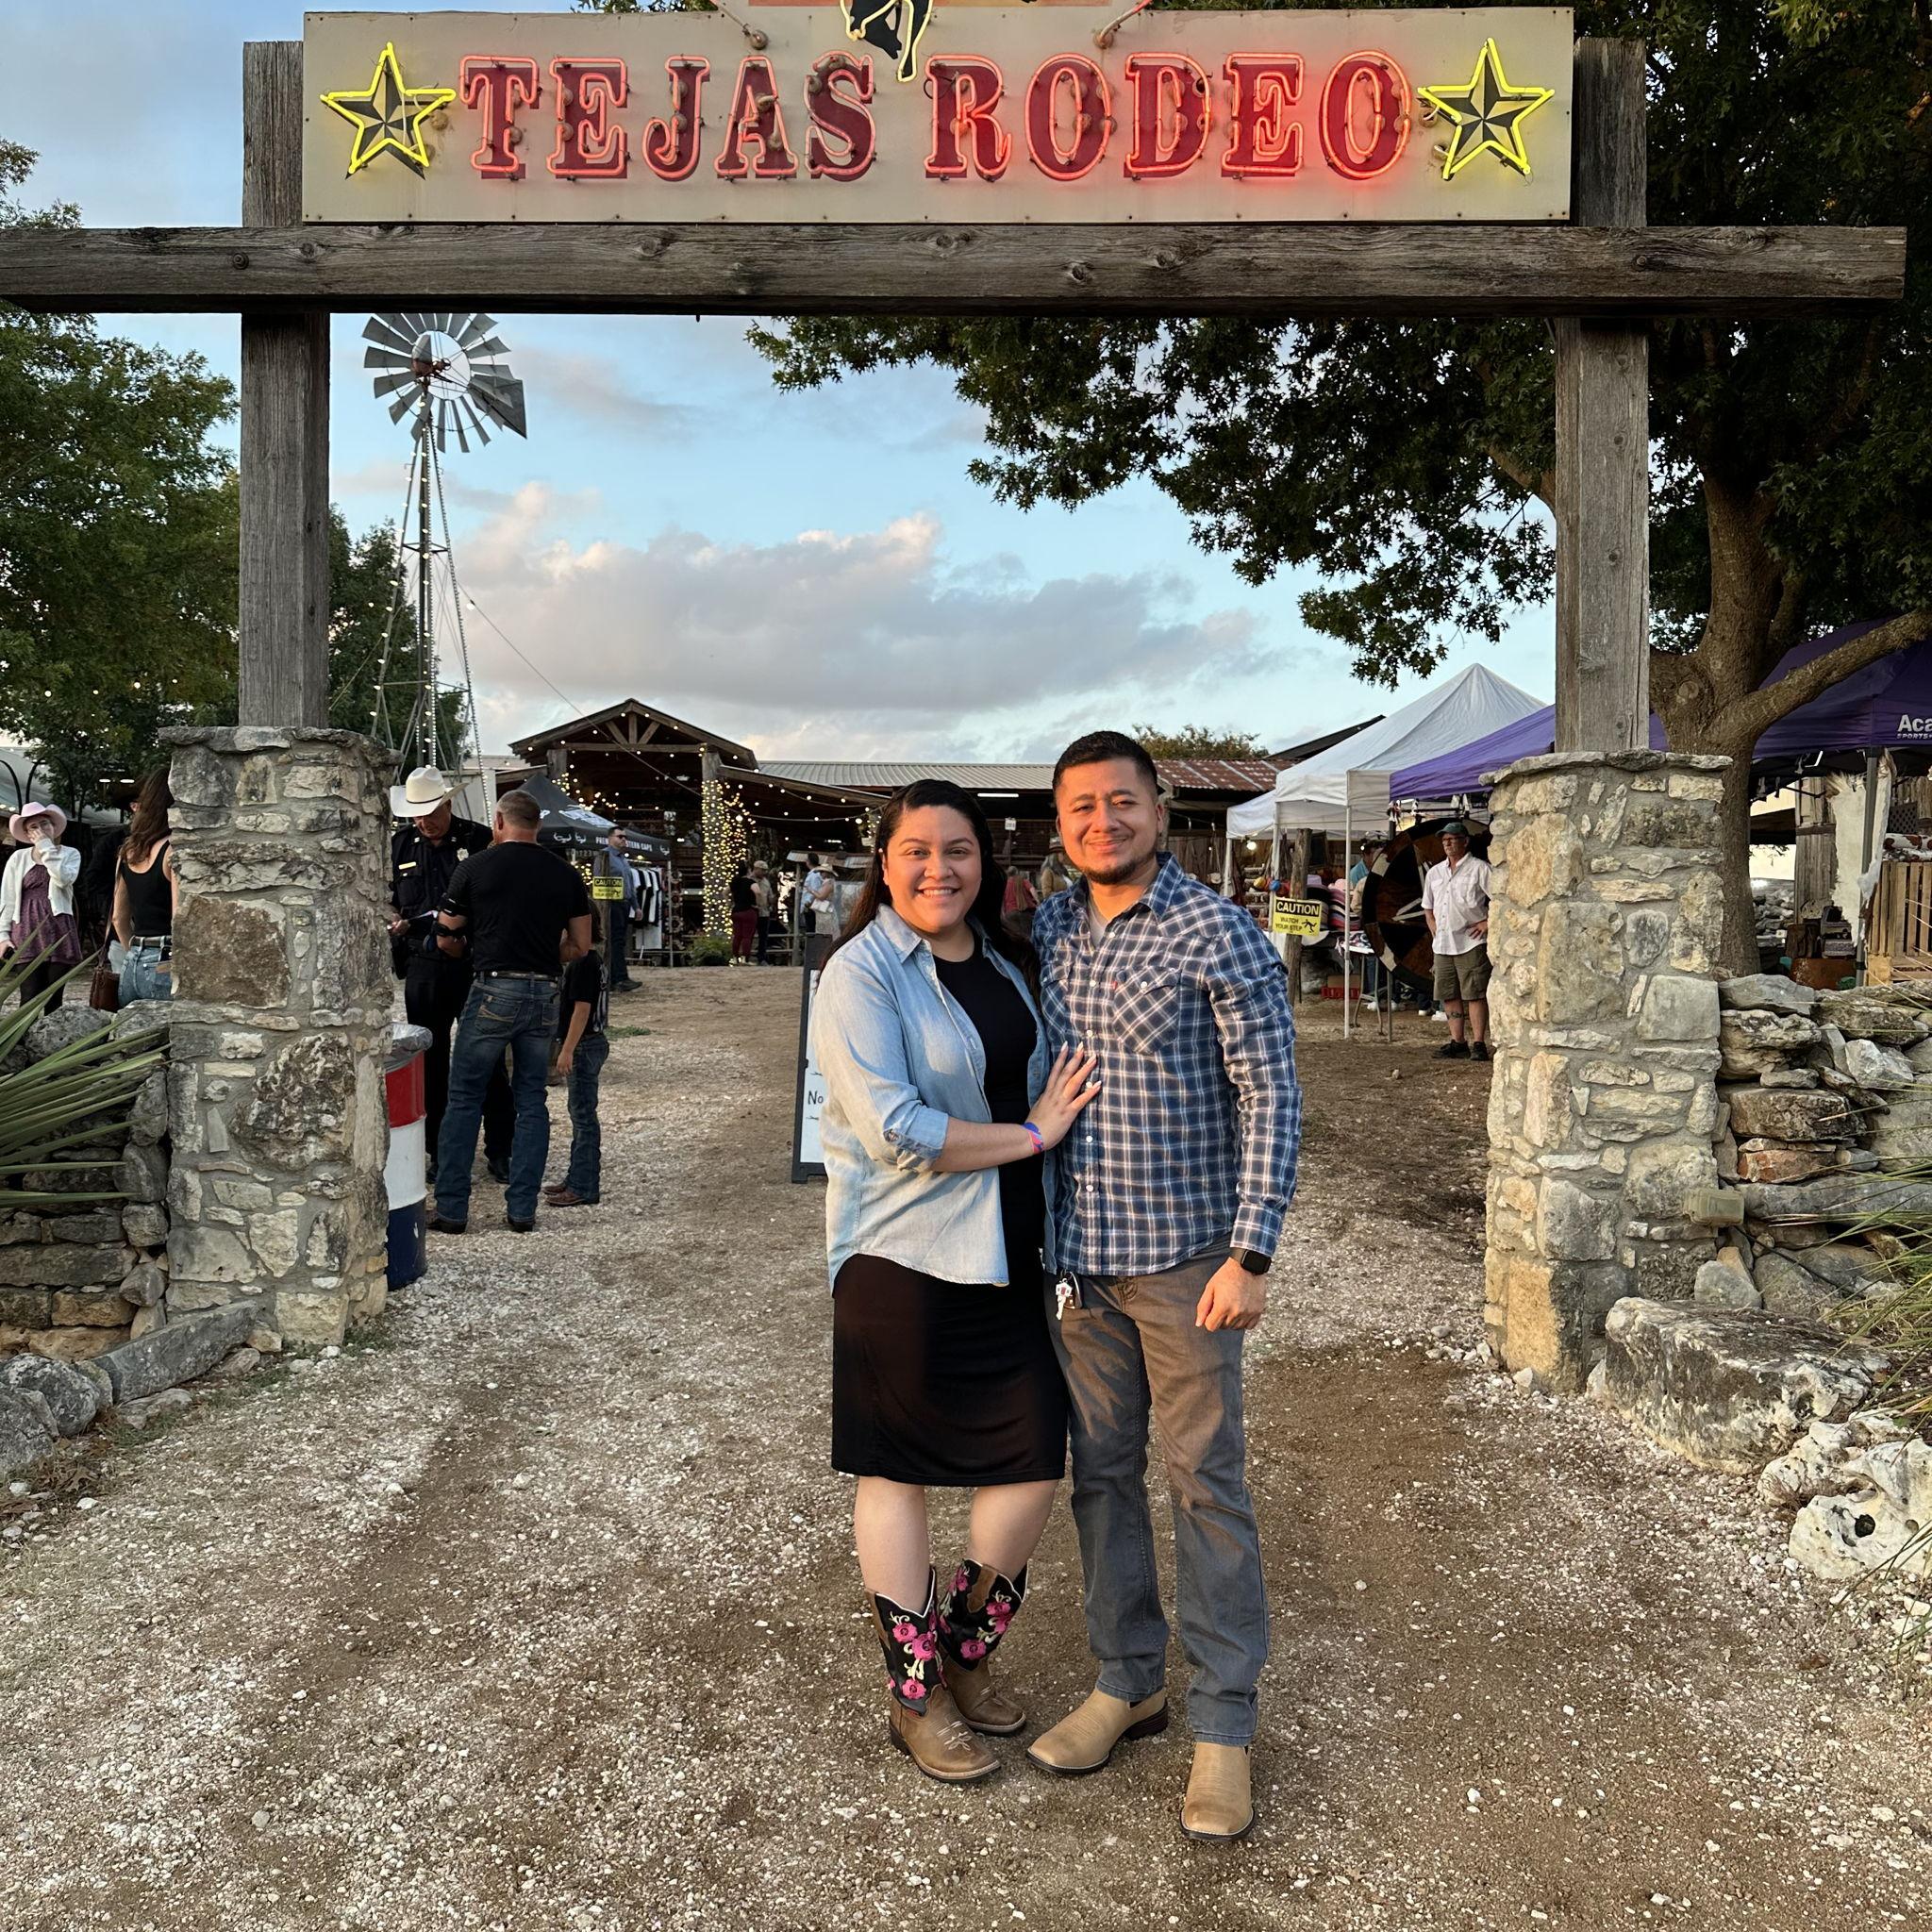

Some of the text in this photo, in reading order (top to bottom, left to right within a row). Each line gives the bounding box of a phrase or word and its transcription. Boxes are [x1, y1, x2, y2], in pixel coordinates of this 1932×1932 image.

[459, 50, 1411, 181] TEJAS RODEO
[1276, 901, 1319, 915] CAUTION
[808, 1090, 824, 1105] No
